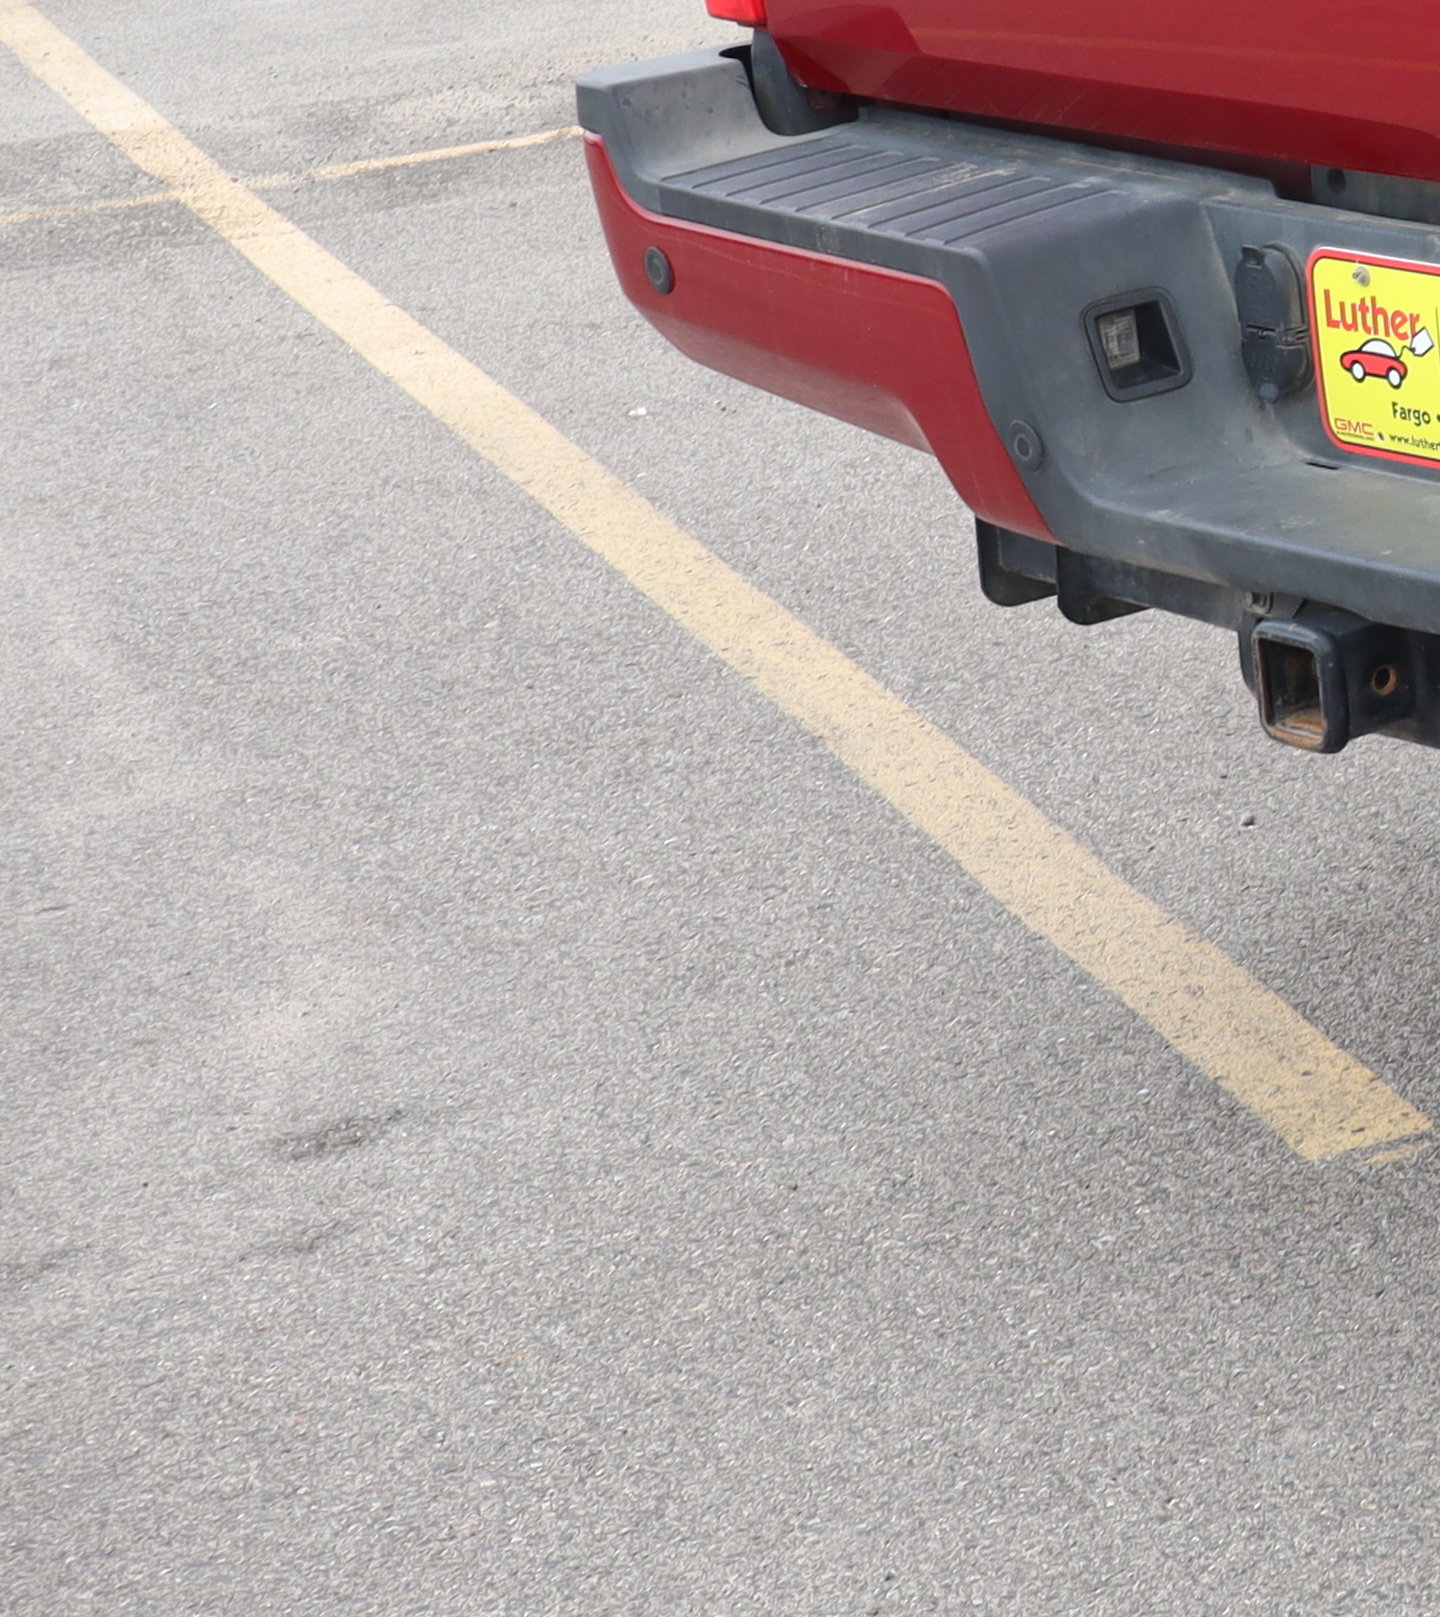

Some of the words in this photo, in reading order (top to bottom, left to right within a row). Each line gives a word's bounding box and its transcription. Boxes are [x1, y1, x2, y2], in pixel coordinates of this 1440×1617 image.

[1323, 288, 1421, 341] Luther
[1334, 417, 1374, 436] GMC
[1391, 401, 1431, 427] Fargo
